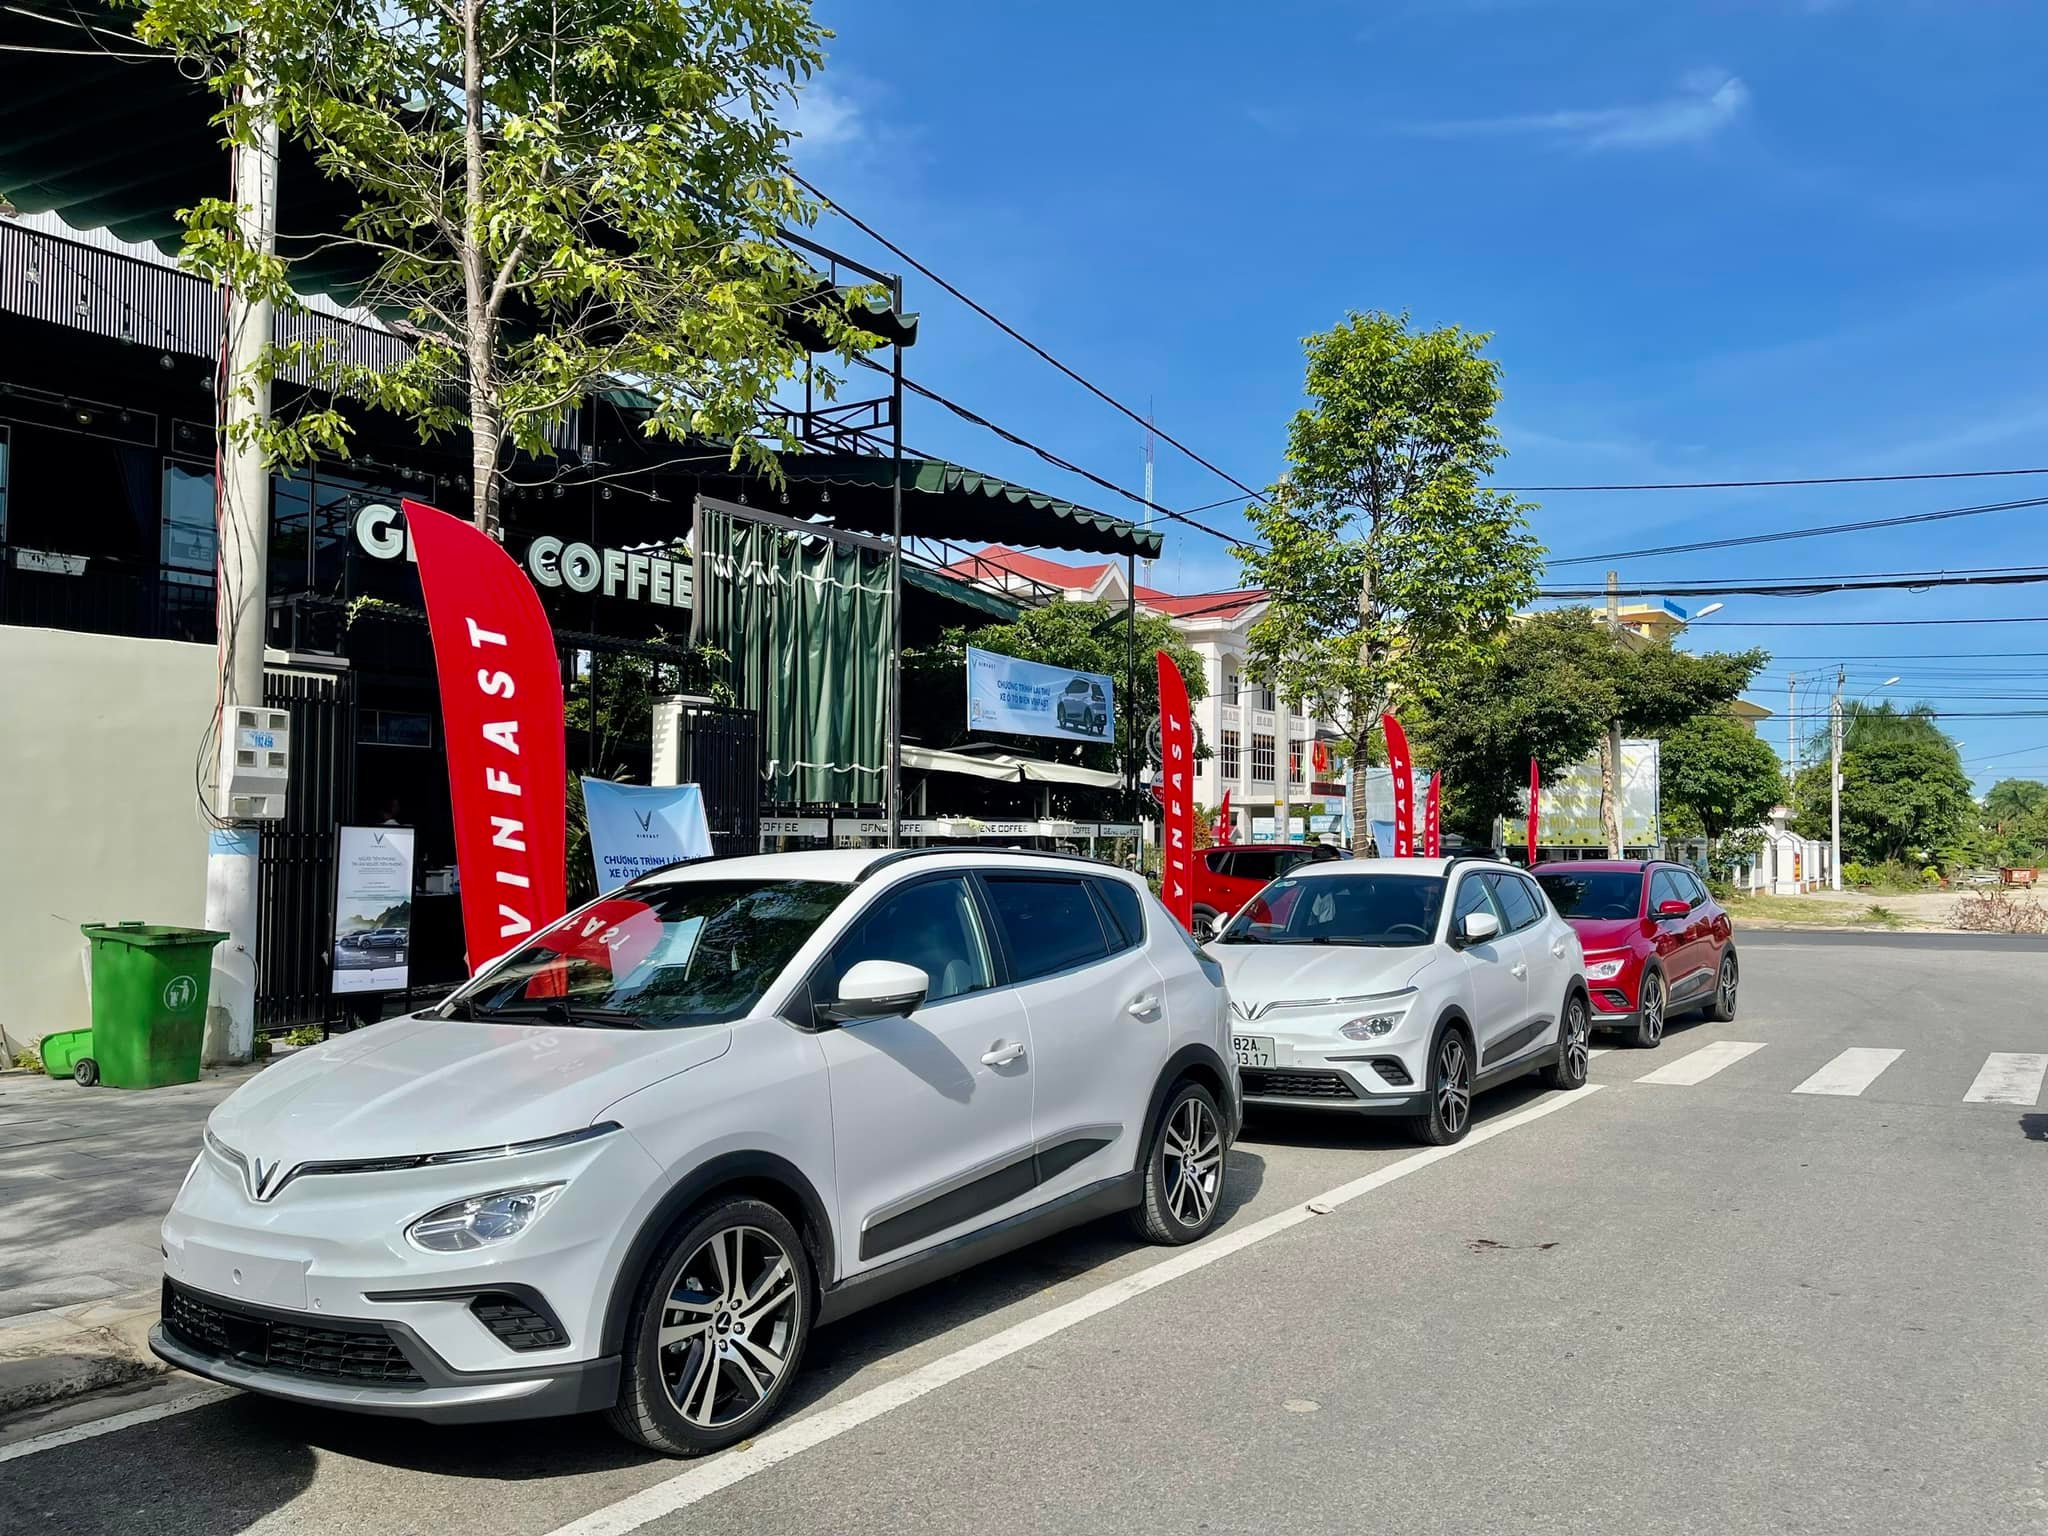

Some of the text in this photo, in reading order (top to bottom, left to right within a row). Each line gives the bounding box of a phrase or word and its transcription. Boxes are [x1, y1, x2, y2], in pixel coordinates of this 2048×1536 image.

[528, 535, 694, 609] COFFEE
[465, 617, 532, 938] VINFAST
[1169, 714, 1184, 898] VINFAST
[604, 854, 638, 865] CHƯƠNG
[640, 854, 665, 865] TRÌNH
[609, 868, 620, 878] XE
